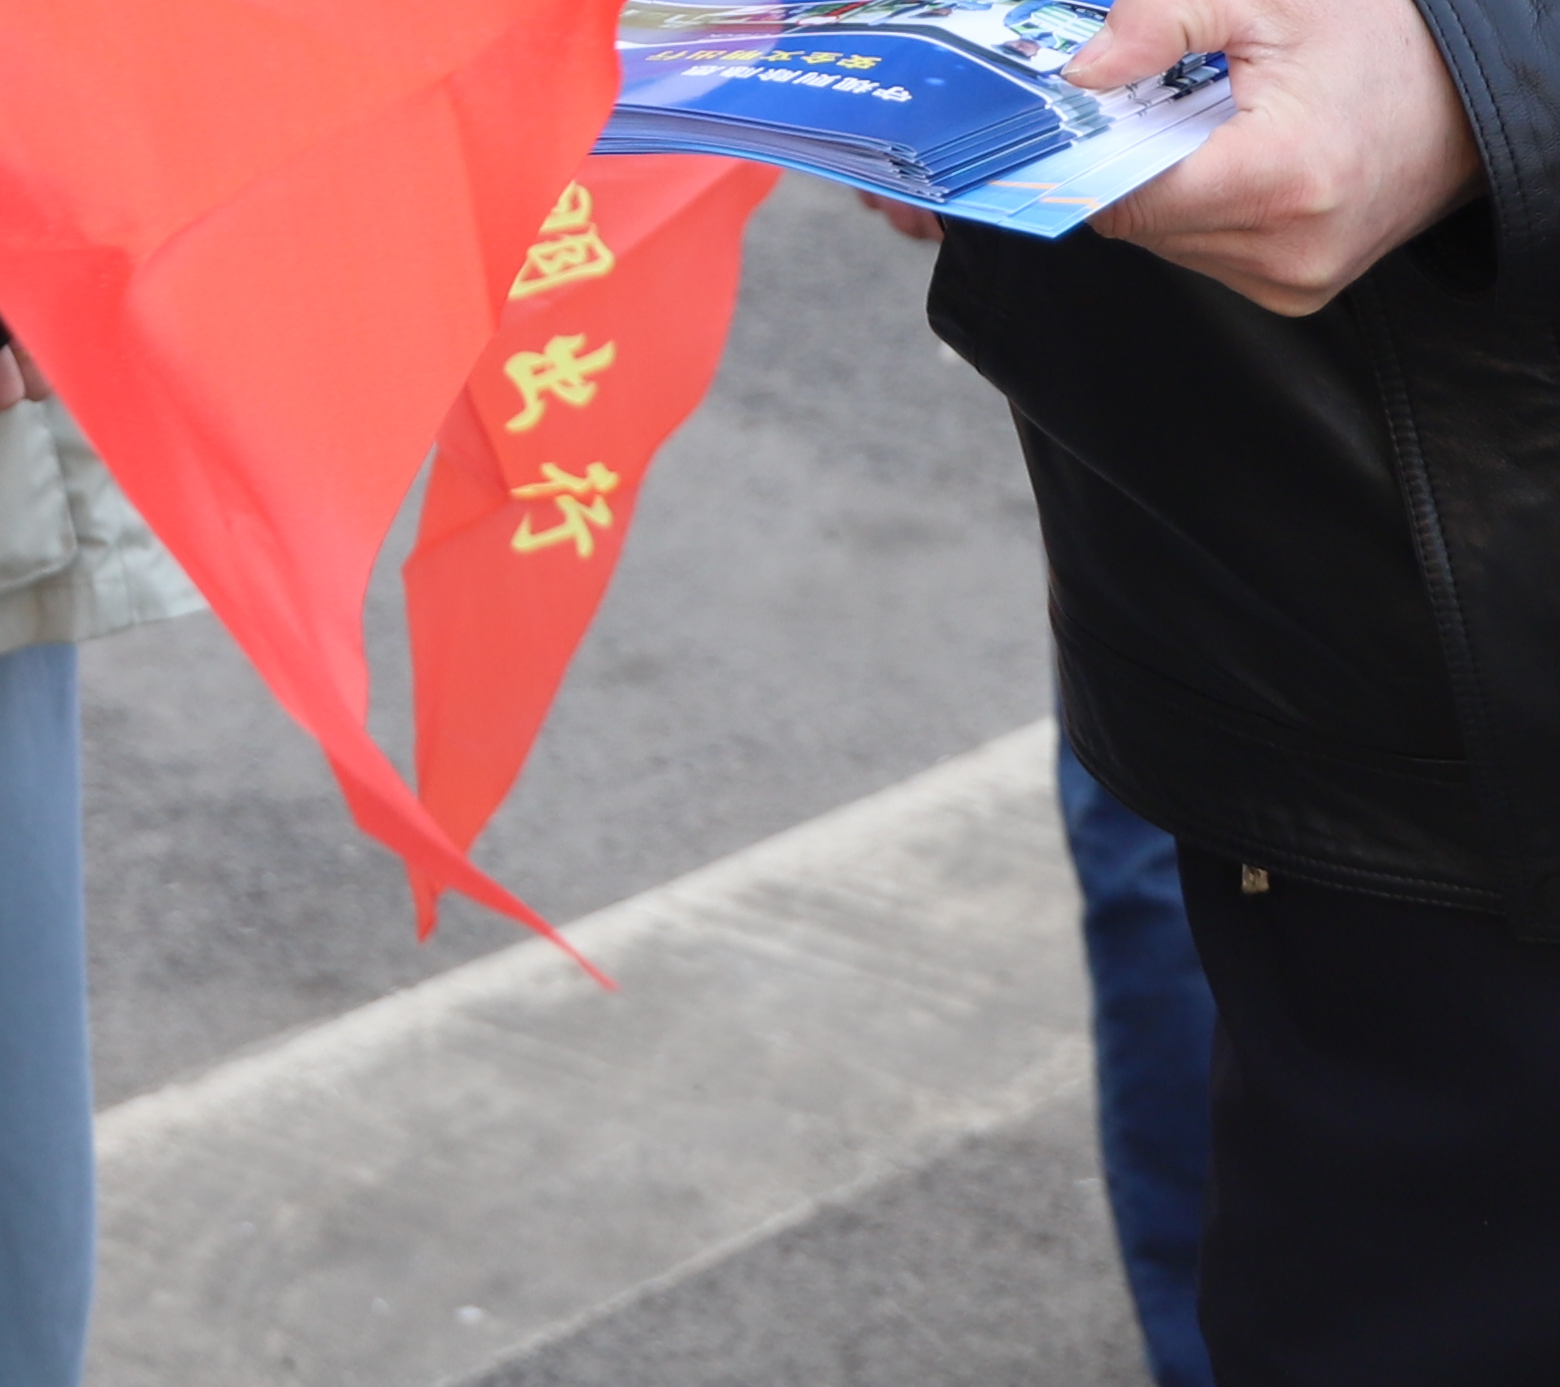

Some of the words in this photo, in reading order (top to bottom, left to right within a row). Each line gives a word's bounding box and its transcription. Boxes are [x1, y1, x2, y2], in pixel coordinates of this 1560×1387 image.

[645, 50, 882, 70] 安全文明出行
